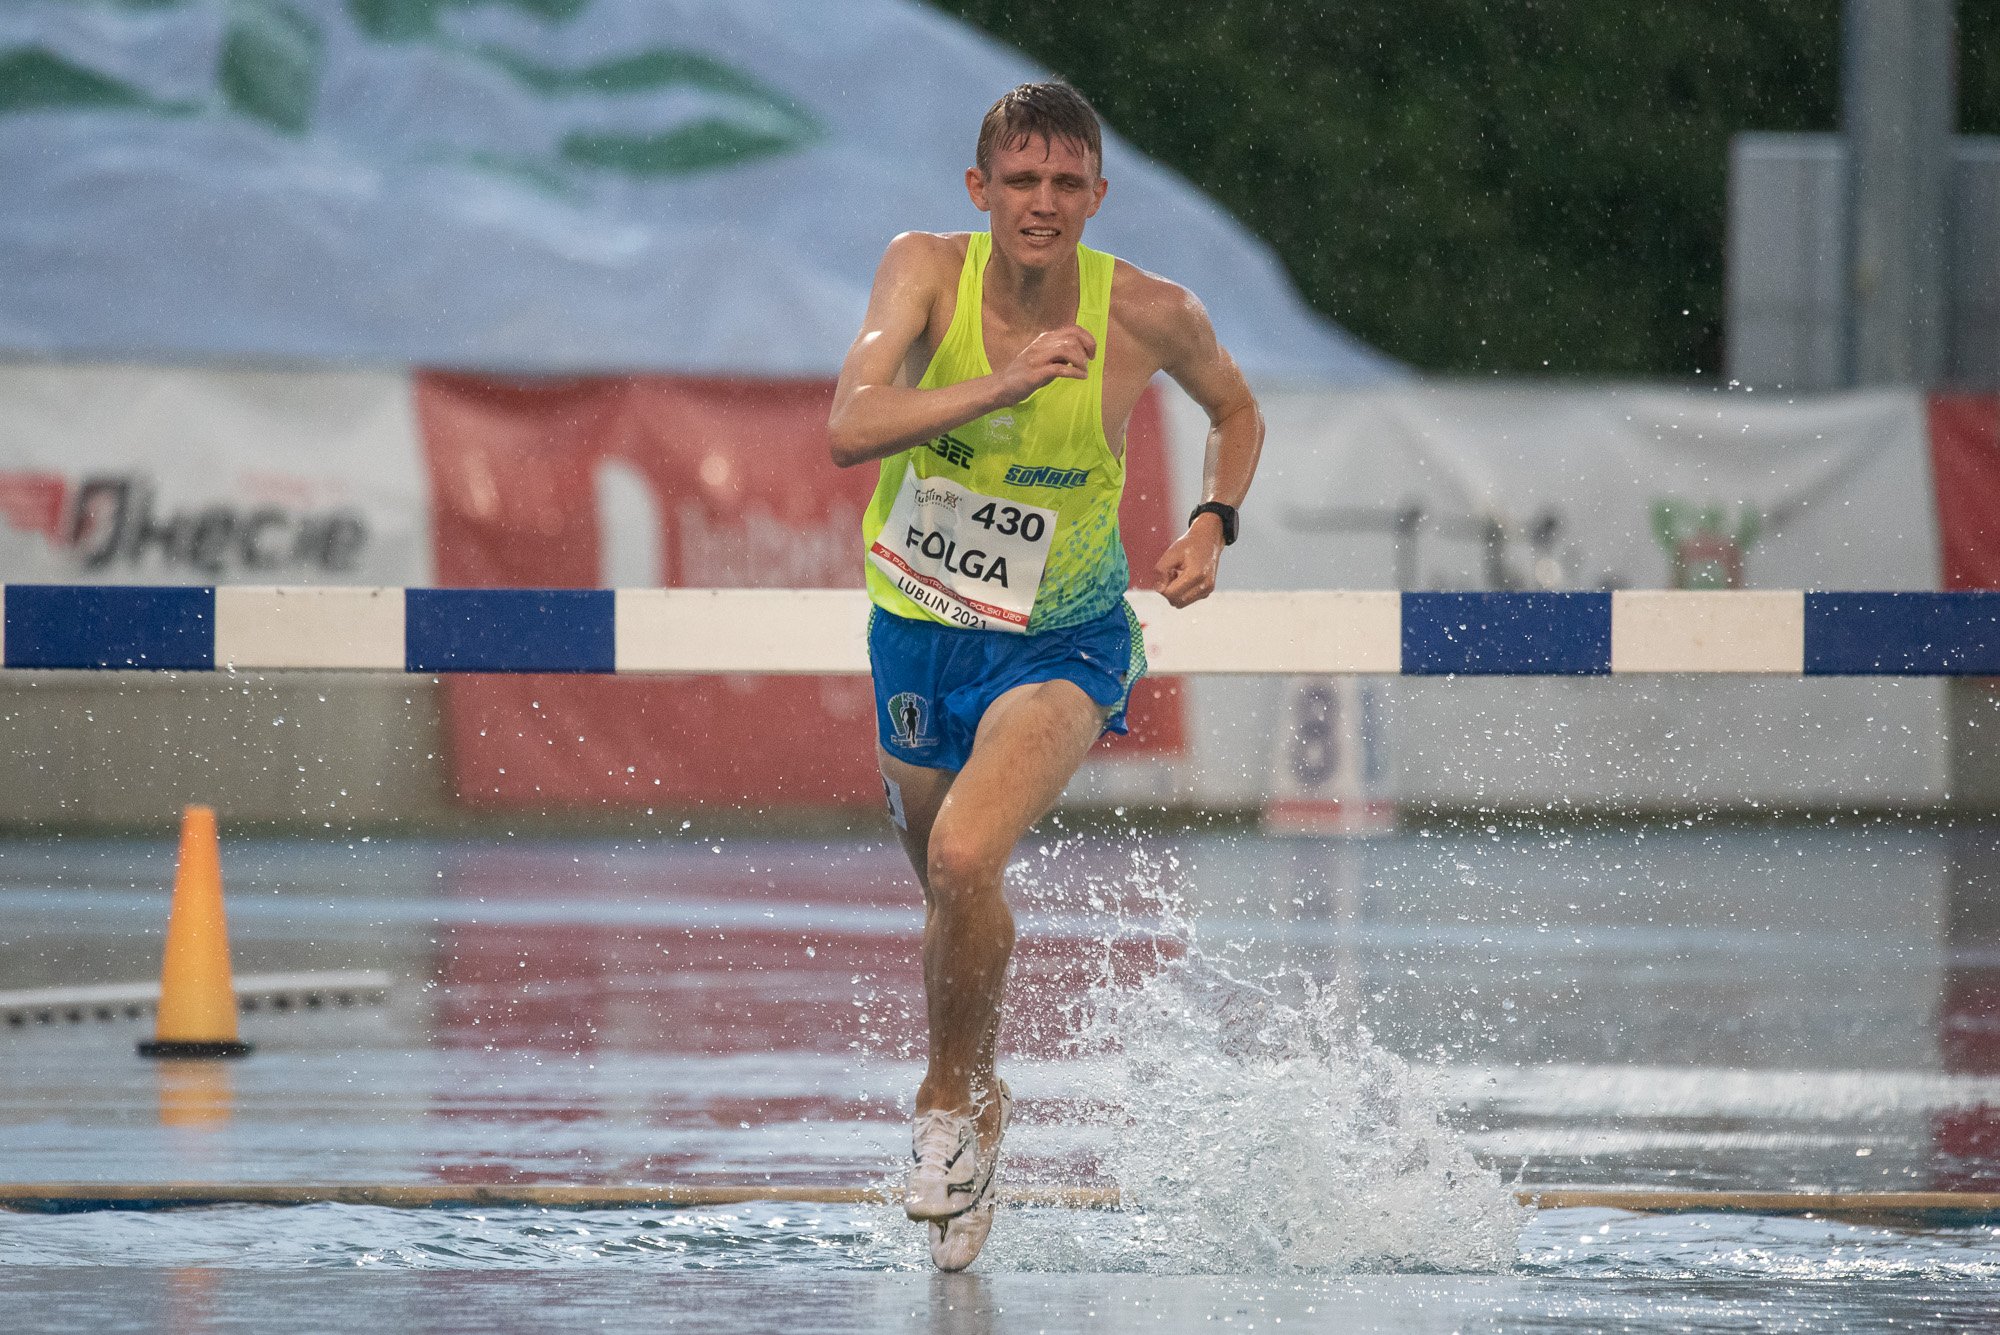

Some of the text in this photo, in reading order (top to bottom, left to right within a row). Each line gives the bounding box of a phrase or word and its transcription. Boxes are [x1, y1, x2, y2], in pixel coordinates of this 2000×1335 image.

[971, 502, 1045, 542] 430
[905, 525, 1009, 589] FOLGA
[892, 556, 913, 575] PZLA
[969, 600, 1002, 617] POLSKI
[1002, 611, 1022, 623] U20
[897, 576, 987, 630] LUBLIN 2021
[902, 692, 915, 701] KS
